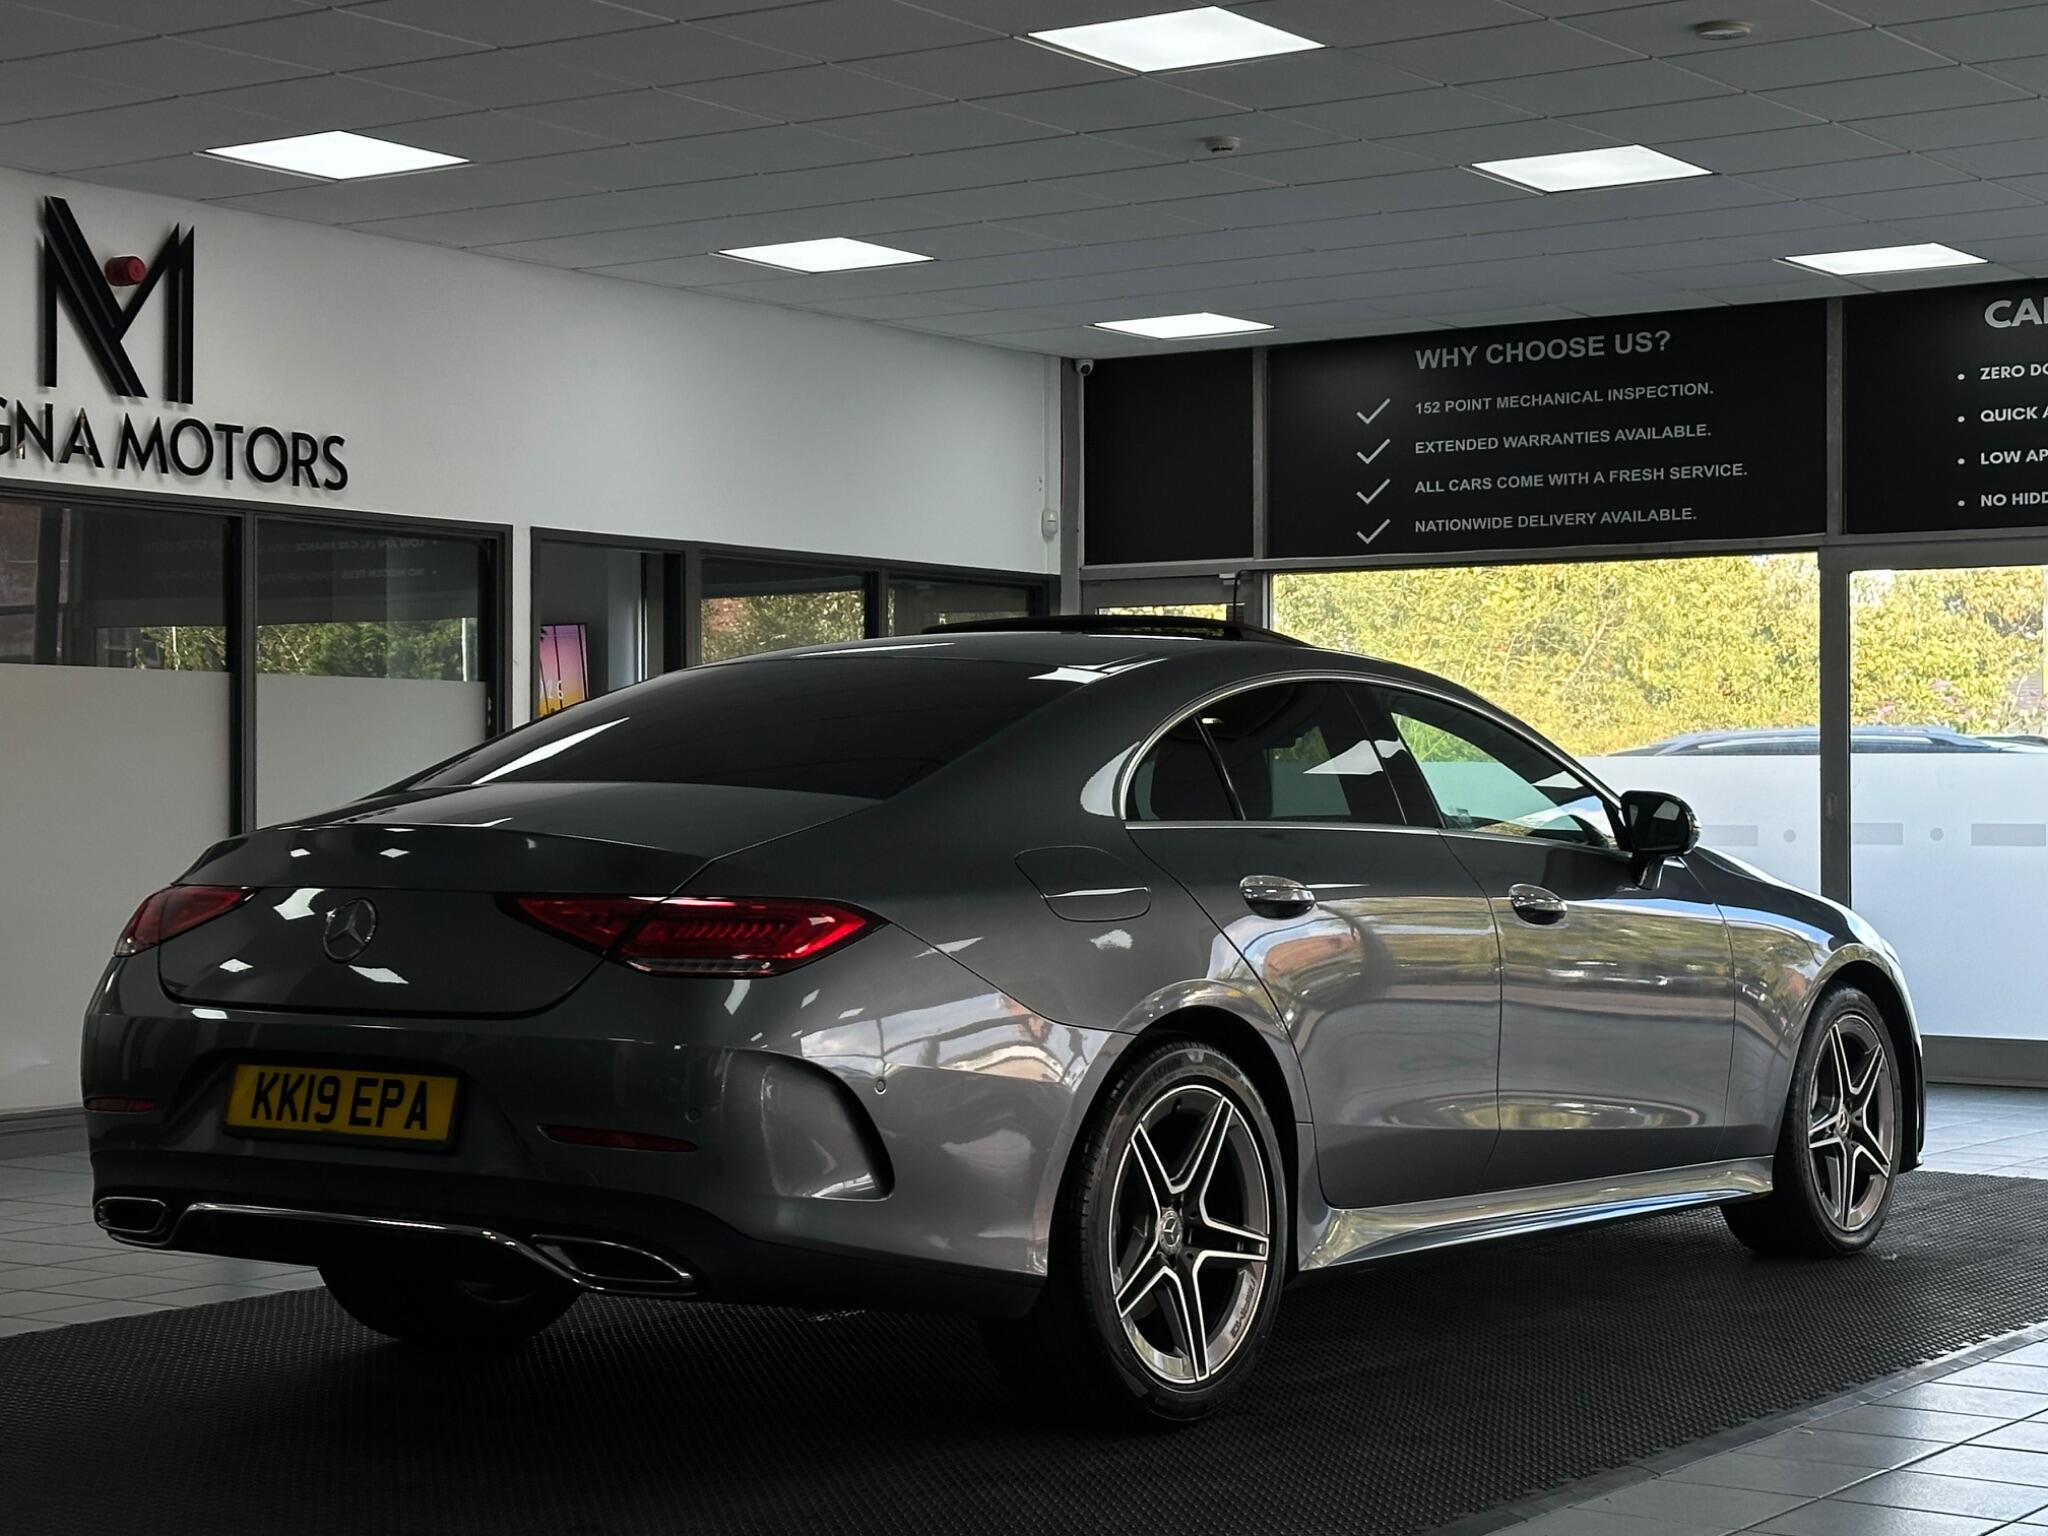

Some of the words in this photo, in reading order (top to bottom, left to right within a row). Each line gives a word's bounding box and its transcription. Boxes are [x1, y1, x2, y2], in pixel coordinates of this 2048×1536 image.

[1984, 297, 2048, 328] CA
[1415, 345, 1478, 370] WHY
[1486, 335, 1605, 364] CHOOSE
[1615, 330, 1671, 355] US?
[1980, 364, 2026, 380] ZERO
[1415, 401, 1440, 415] 152
[1444, 397, 1492, 413] POINT
[1496, 390, 1603, 409] MECHANICAL
[1607, 382, 1714, 401] INSPECTION.
[1980, 406, 2038, 423] QUICK
[117, 412, 349, 491] MOTORS
[1415, 437, 1499, 454] EXTENDED
[1502, 430, 1611, 449] WARRANTIES
[1614, 424, 1712, 442] AVAILABLE.
[1980, 450, 2022, 465] LOW
[1415, 480, 1445, 494] ALL
[1448, 477, 1493, 492] CARS
[1496, 474, 1544, 489] COME
[1548, 471, 1589, 486] WITH
[1593, 471, 1605, 484] A
[1609, 467, 1665, 483] FRESH
[1669, 463, 1748, 480] SERVICE.
[1980, 493, 2007, 507] NO
[1415, 516, 1513, 533] NATIONWIDE
[1517, 511, 1596, 528] DELIVERY
[1599, 507, 1697, 525] AVAILABLE.
[250, 1071, 341, 1124] KK19
[348, 1077, 428, 1131] EPA
